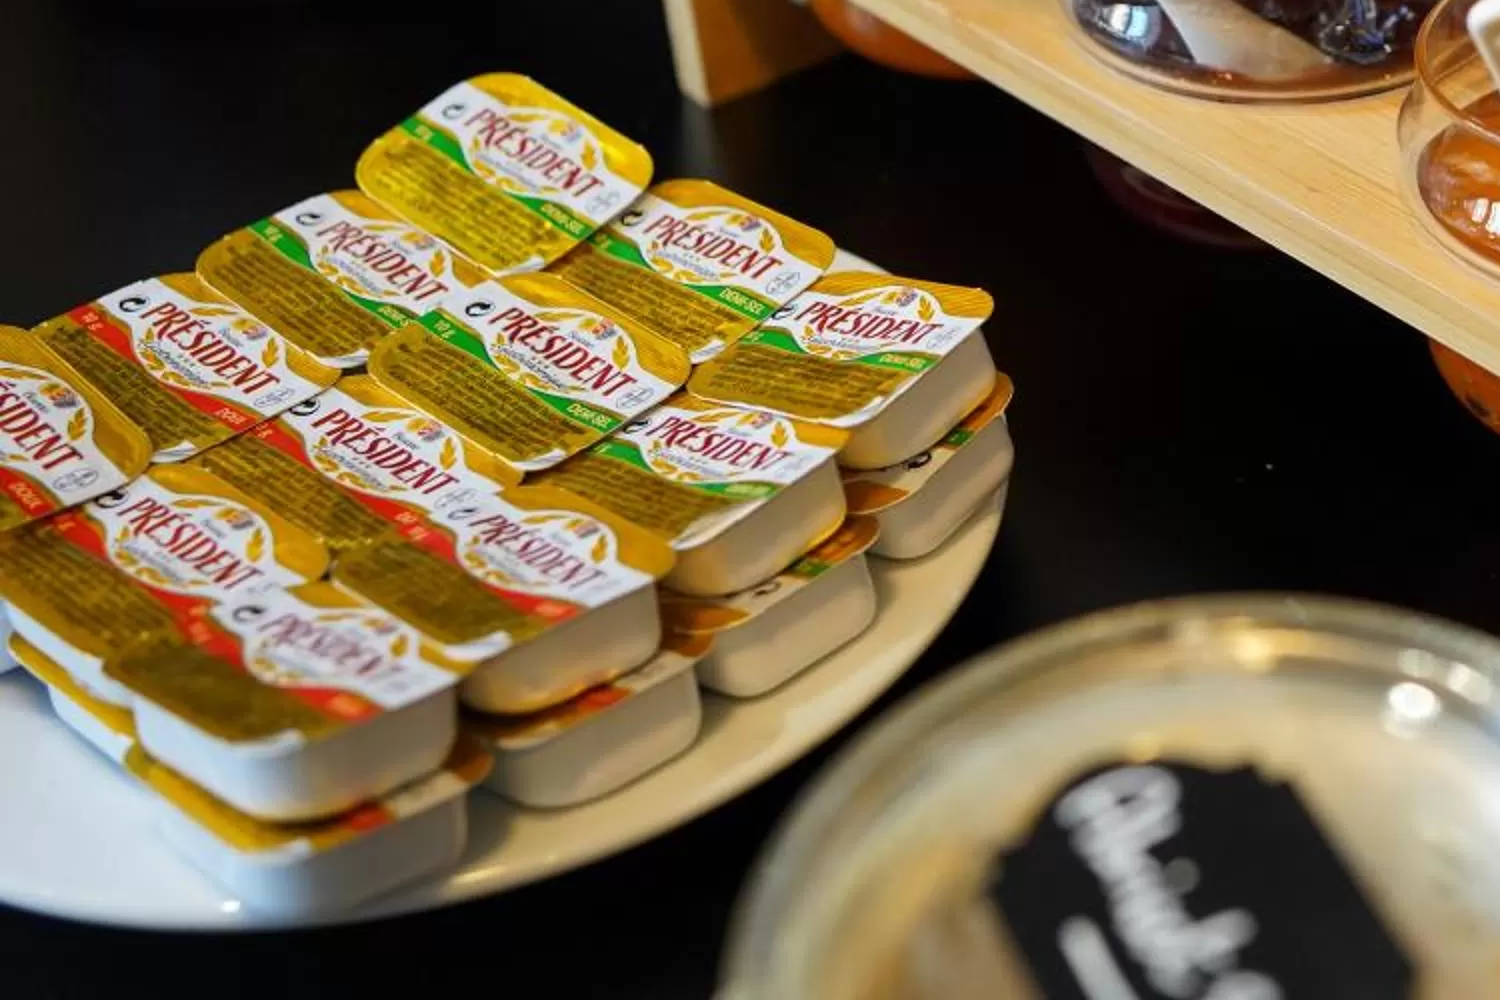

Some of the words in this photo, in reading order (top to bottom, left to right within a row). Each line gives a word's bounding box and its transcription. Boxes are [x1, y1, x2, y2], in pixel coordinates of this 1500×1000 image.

[316, 220, 449, 301] PRÉSIDENT
[642, 214, 783, 280] PRÉSIDENT
[139, 301, 281, 394] PRÉSIDENT
[488, 307, 637, 397] PRÉSIDENT
[796, 301, 945, 345] PRÉSIDENT
[311, 408, 460, 495] PRÉSIDENT
[646, 416, 794, 470] PRÉSIDENT
[117, 497, 265, 590] PRÉSIDENT
